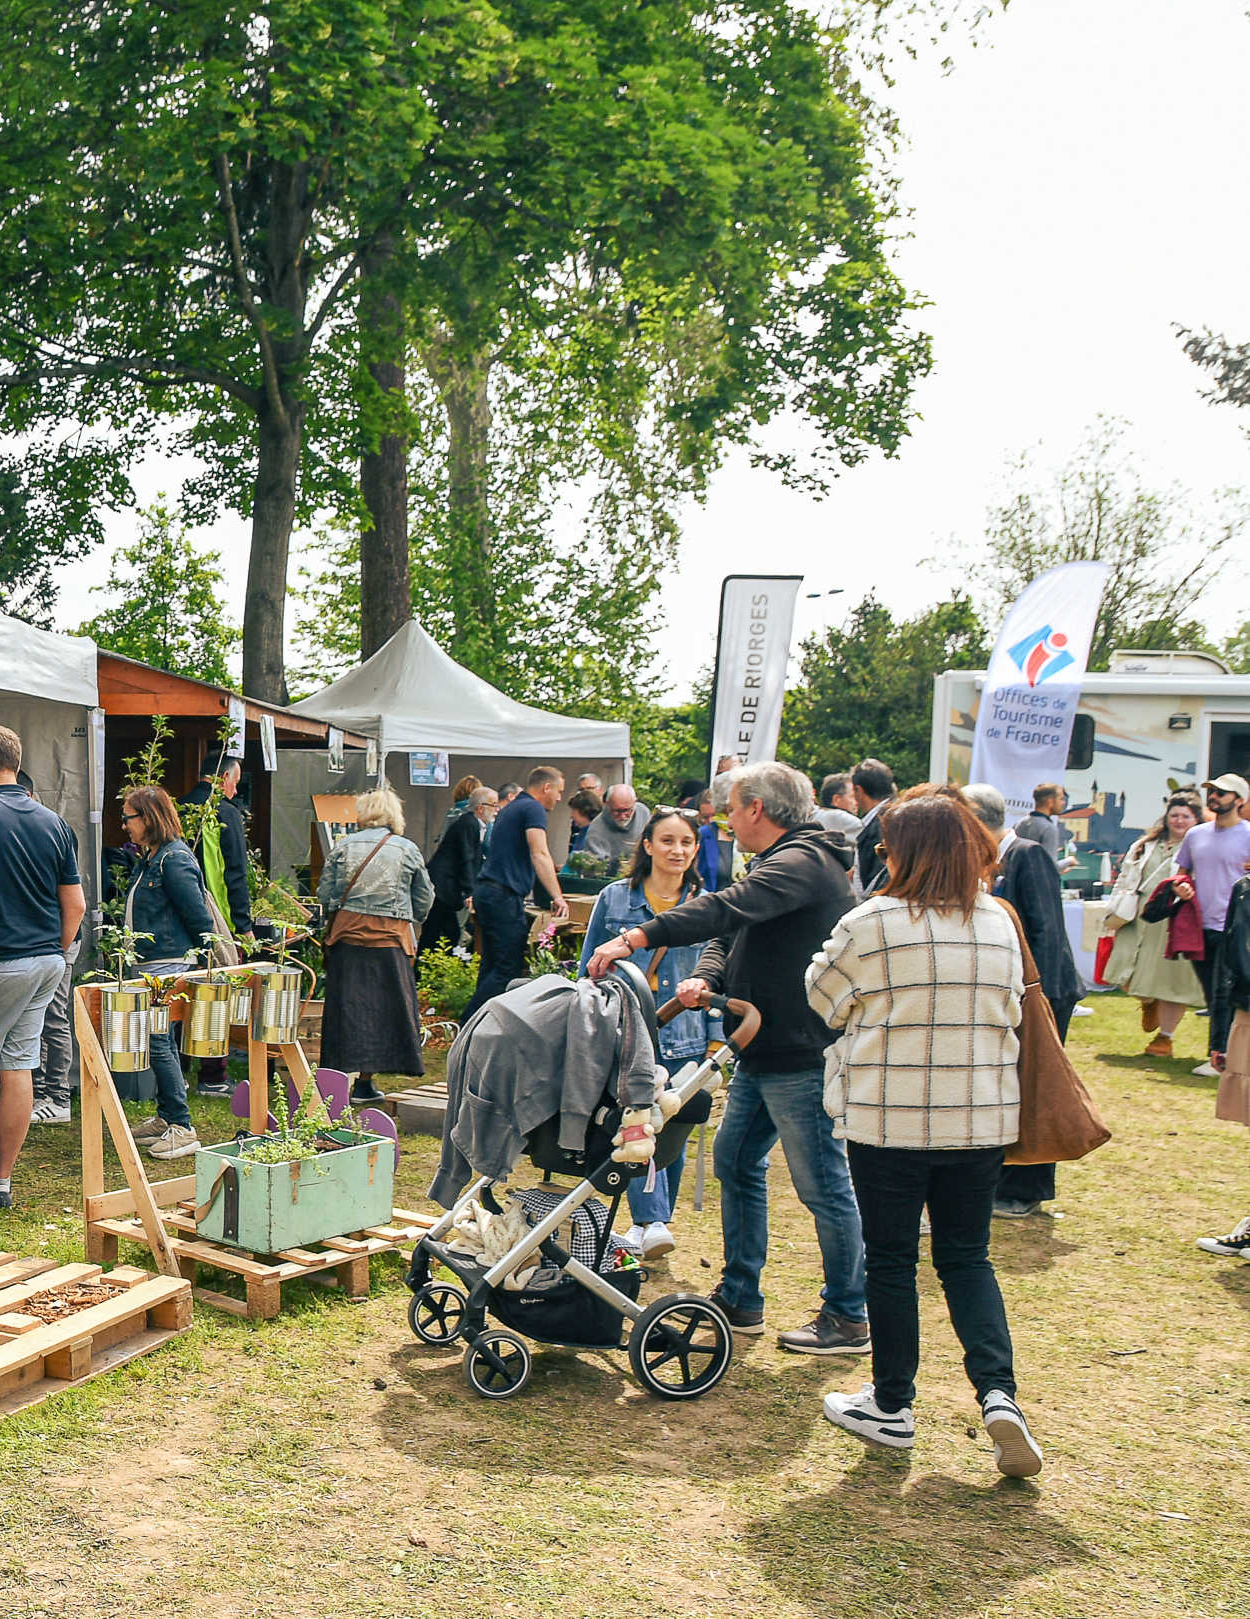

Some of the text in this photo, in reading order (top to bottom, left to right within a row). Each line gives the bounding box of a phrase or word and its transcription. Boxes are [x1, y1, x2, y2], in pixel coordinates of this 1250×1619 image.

[744, 594, 769, 689] RIORGES
[740, 696, 760, 724] DE
[993, 687, 1067, 710] Offices de
[992, 704, 1064, 729] Tourisme
[985, 725, 1061, 747] de France
